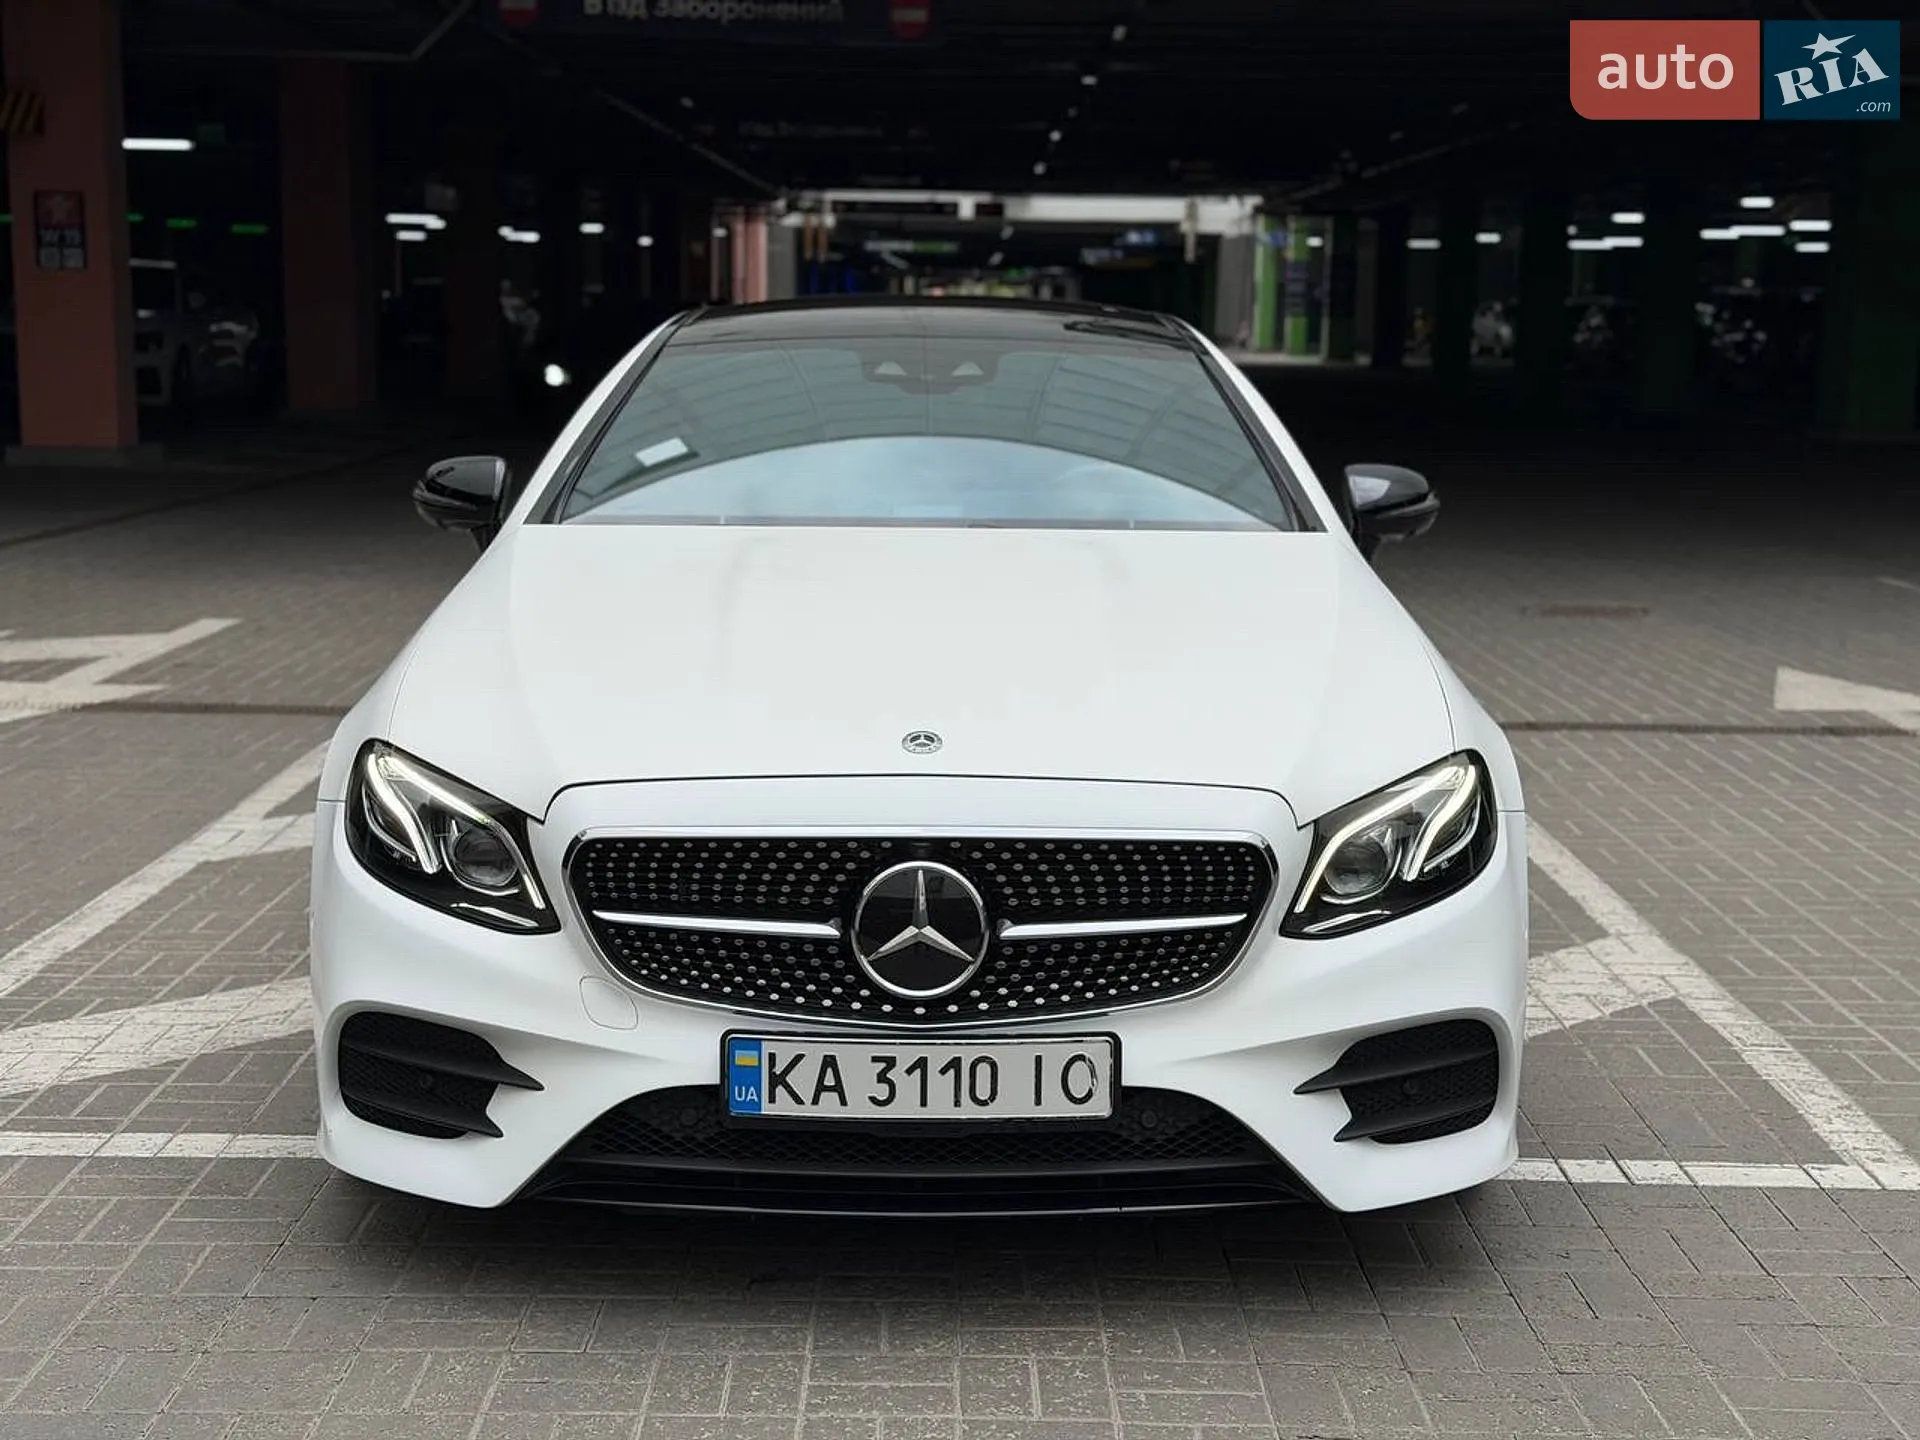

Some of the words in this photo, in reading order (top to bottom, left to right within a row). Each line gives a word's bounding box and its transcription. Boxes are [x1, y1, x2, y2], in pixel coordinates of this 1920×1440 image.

[735, 1085, 759, 1103] UA
[768, 1052, 848, 1106] KA
[867, 1055, 999, 1108] 3110
[1034, 1053, 1098, 1106] IO
